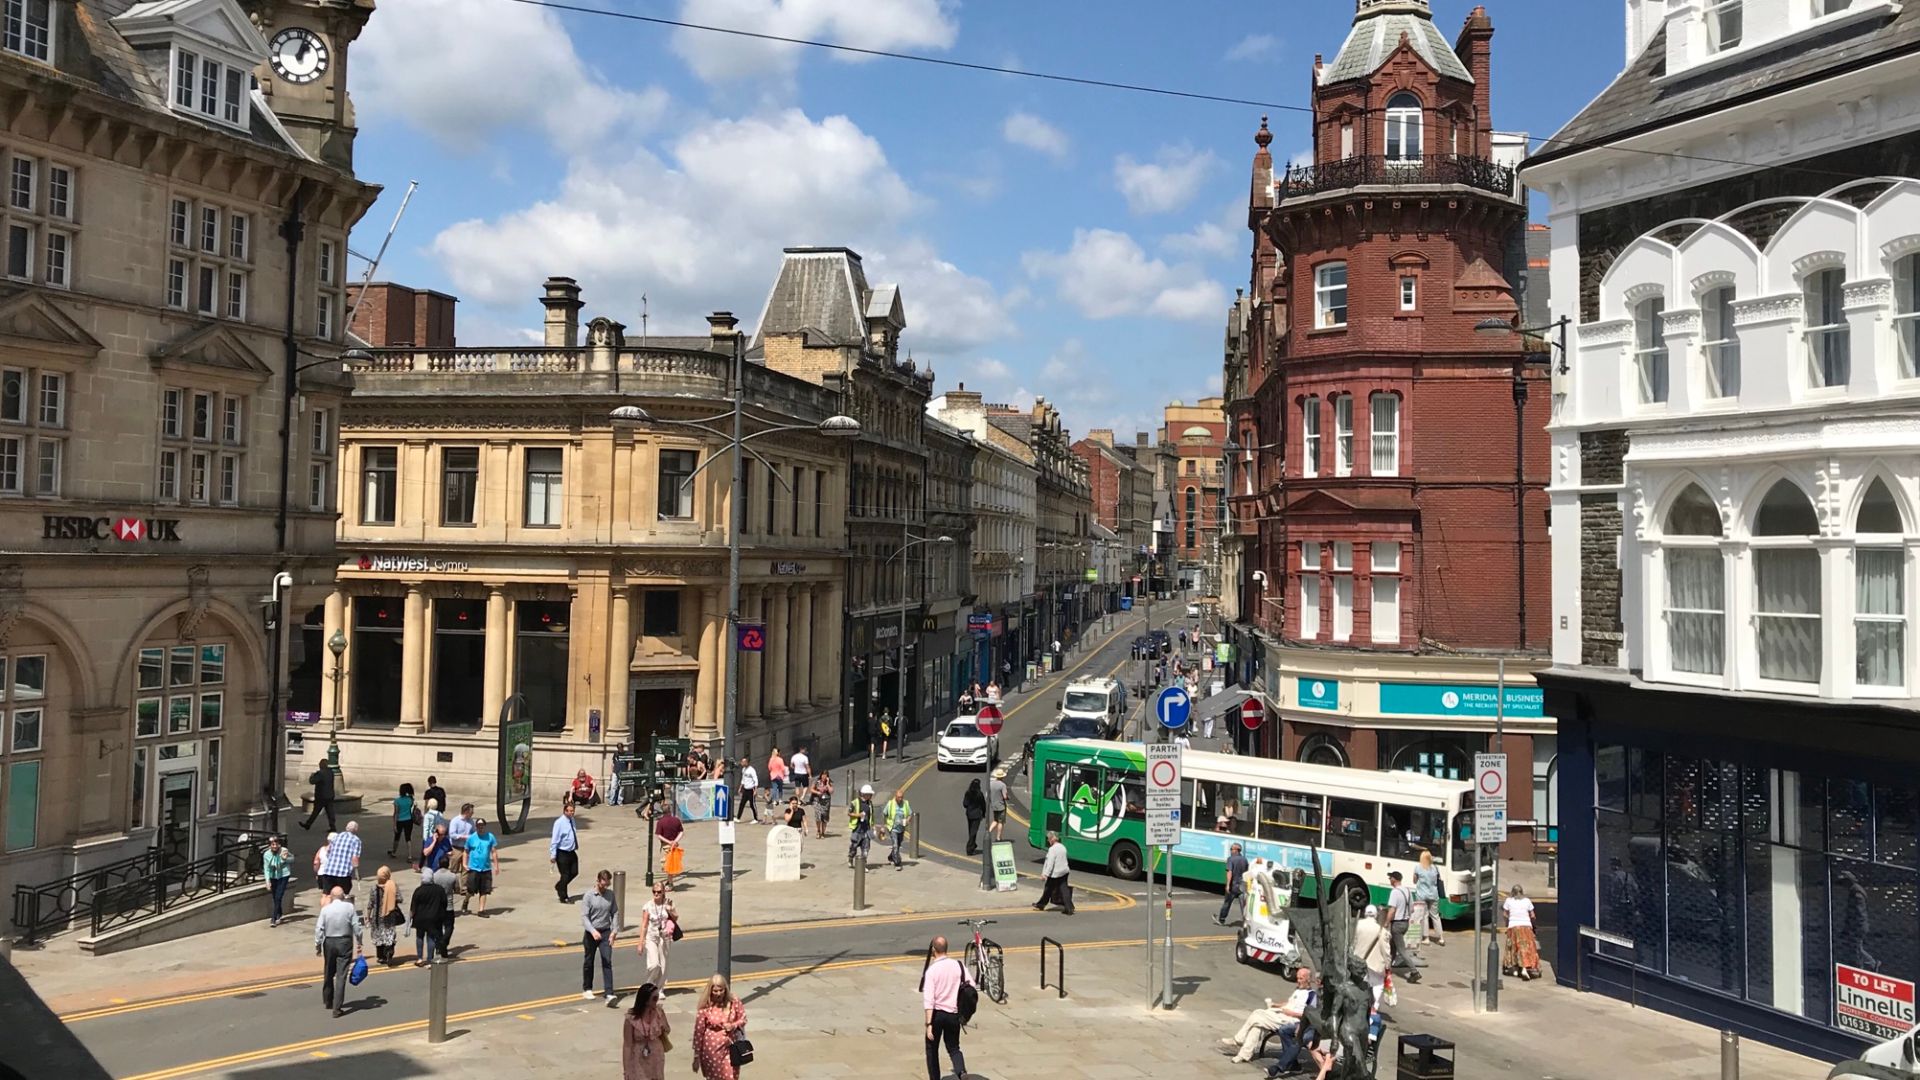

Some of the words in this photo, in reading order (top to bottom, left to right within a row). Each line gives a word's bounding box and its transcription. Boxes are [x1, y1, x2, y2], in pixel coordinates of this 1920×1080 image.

[42, 516, 110, 540] HSBC
[145, 519, 181, 541] UK
[374, 555, 429, 570] NatWest
[434, 559, 469, 571] Cymru
[1463, 693, 1499, 701] MERIDIA
[1506, 694, 1544, 703] BUSINESS
[1480, 760, 1501, 768] ZONE
[1852, 973, 1869, 987] TO
[1873, 979, 1896, 994] LET
[1838, 985, 1913, 1022] Linnells
[1839, 1005, 1868, 1018] PROPERTY
[1841, 1015, 1871, 1032] 01633
